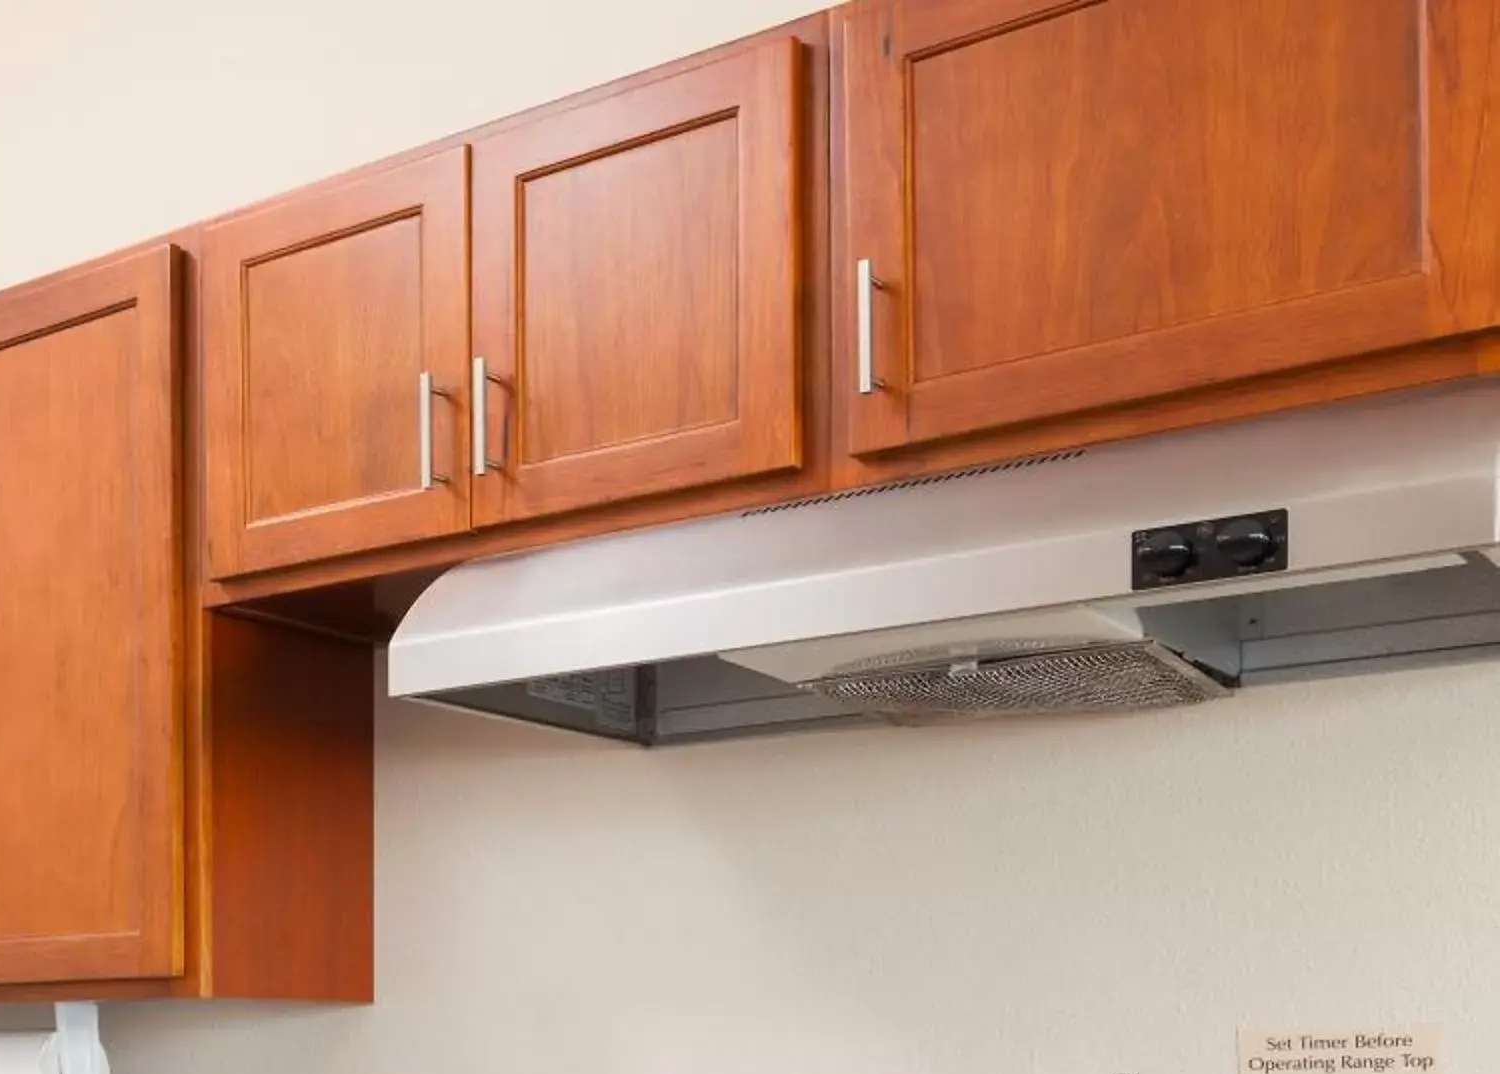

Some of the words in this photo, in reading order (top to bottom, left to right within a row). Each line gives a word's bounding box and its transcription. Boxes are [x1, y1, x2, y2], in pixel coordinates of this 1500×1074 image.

[1266, 1036, 1292, 1051] Set
[1299, 1034, 1349, 1050] Timer
[1355, 1032, 1414, 1049] Before
[1341, 1054, 1396, 1072] Range
[1401, 1053, 1435, 1072] Top
